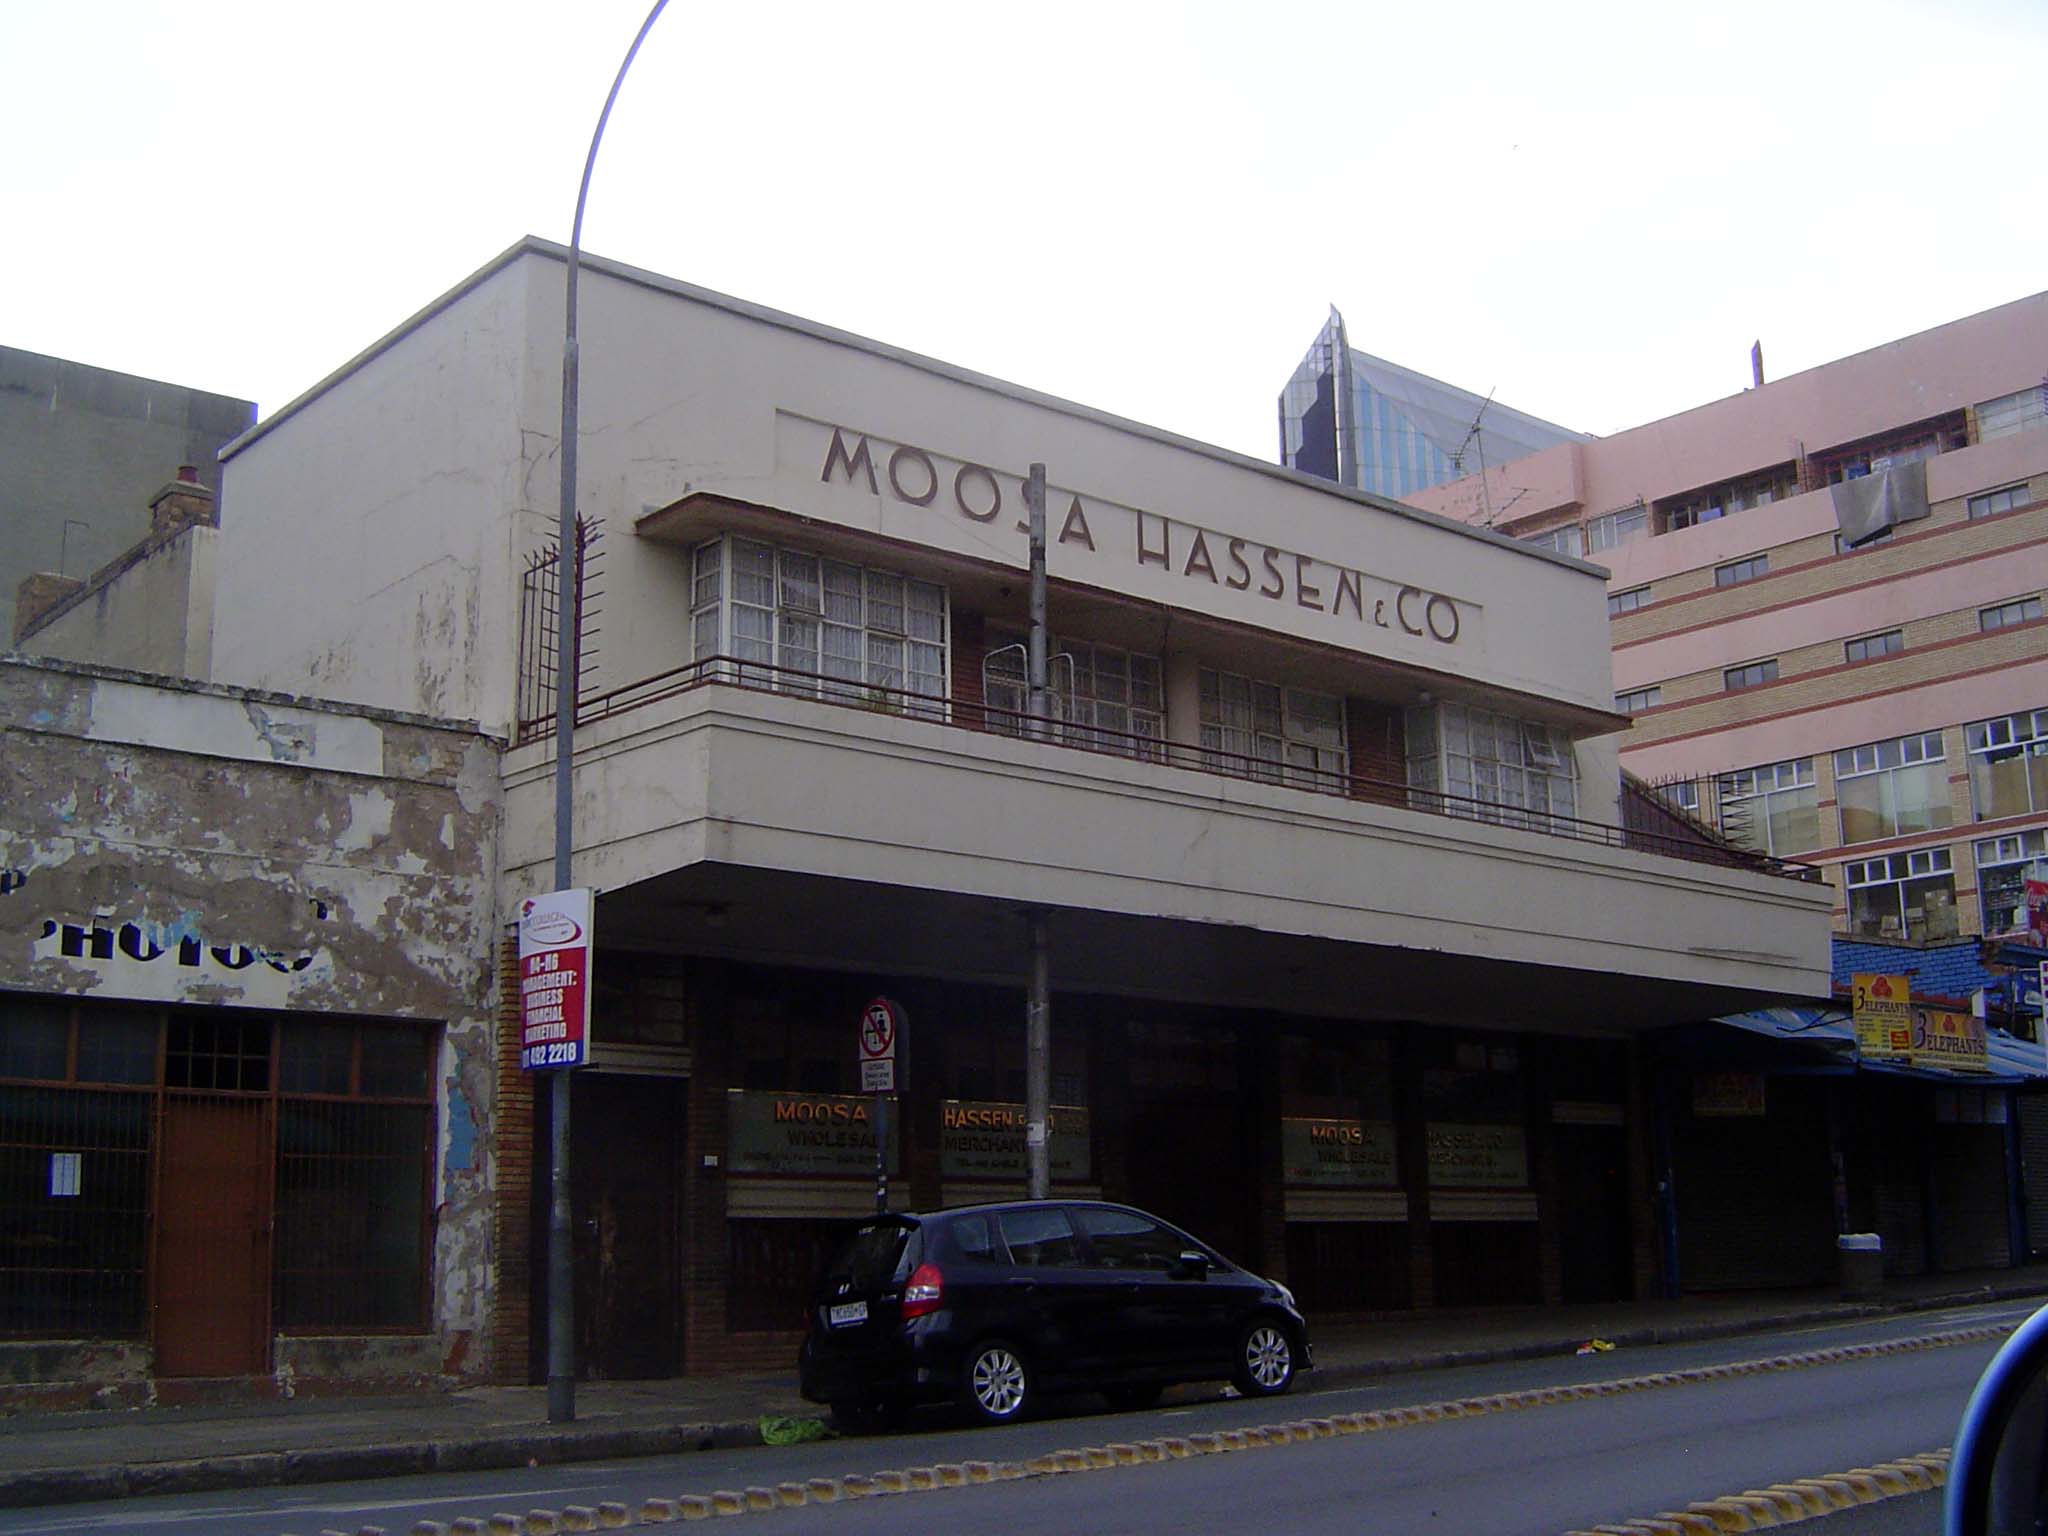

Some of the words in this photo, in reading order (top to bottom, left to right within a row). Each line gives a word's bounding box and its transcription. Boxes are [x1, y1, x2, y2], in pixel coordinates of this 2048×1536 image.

[1137, 509, 1363, 622] HASSEN
[1397, 583, 1460, 644] CO
[1856, 986, 1866, 1011] 3
[1865, 1001, 1910, 1014] ELEPHANTS
[1914, 1011, 1927, 1049] 3
[1926, 1033, 1985, 1055] ELEPHANTS
[548, 1041, 577, 1063] 2218
[775, 1100, 869, 1127] MOOSA
[943, 1107, 1014, 1132] HASSEN
[787, 1129, 881, 1150] WHOLESAL
[944, 1134, 1027, 1153] MERCHANT
[1310, 1125, 1376, 1145] MOOSA
